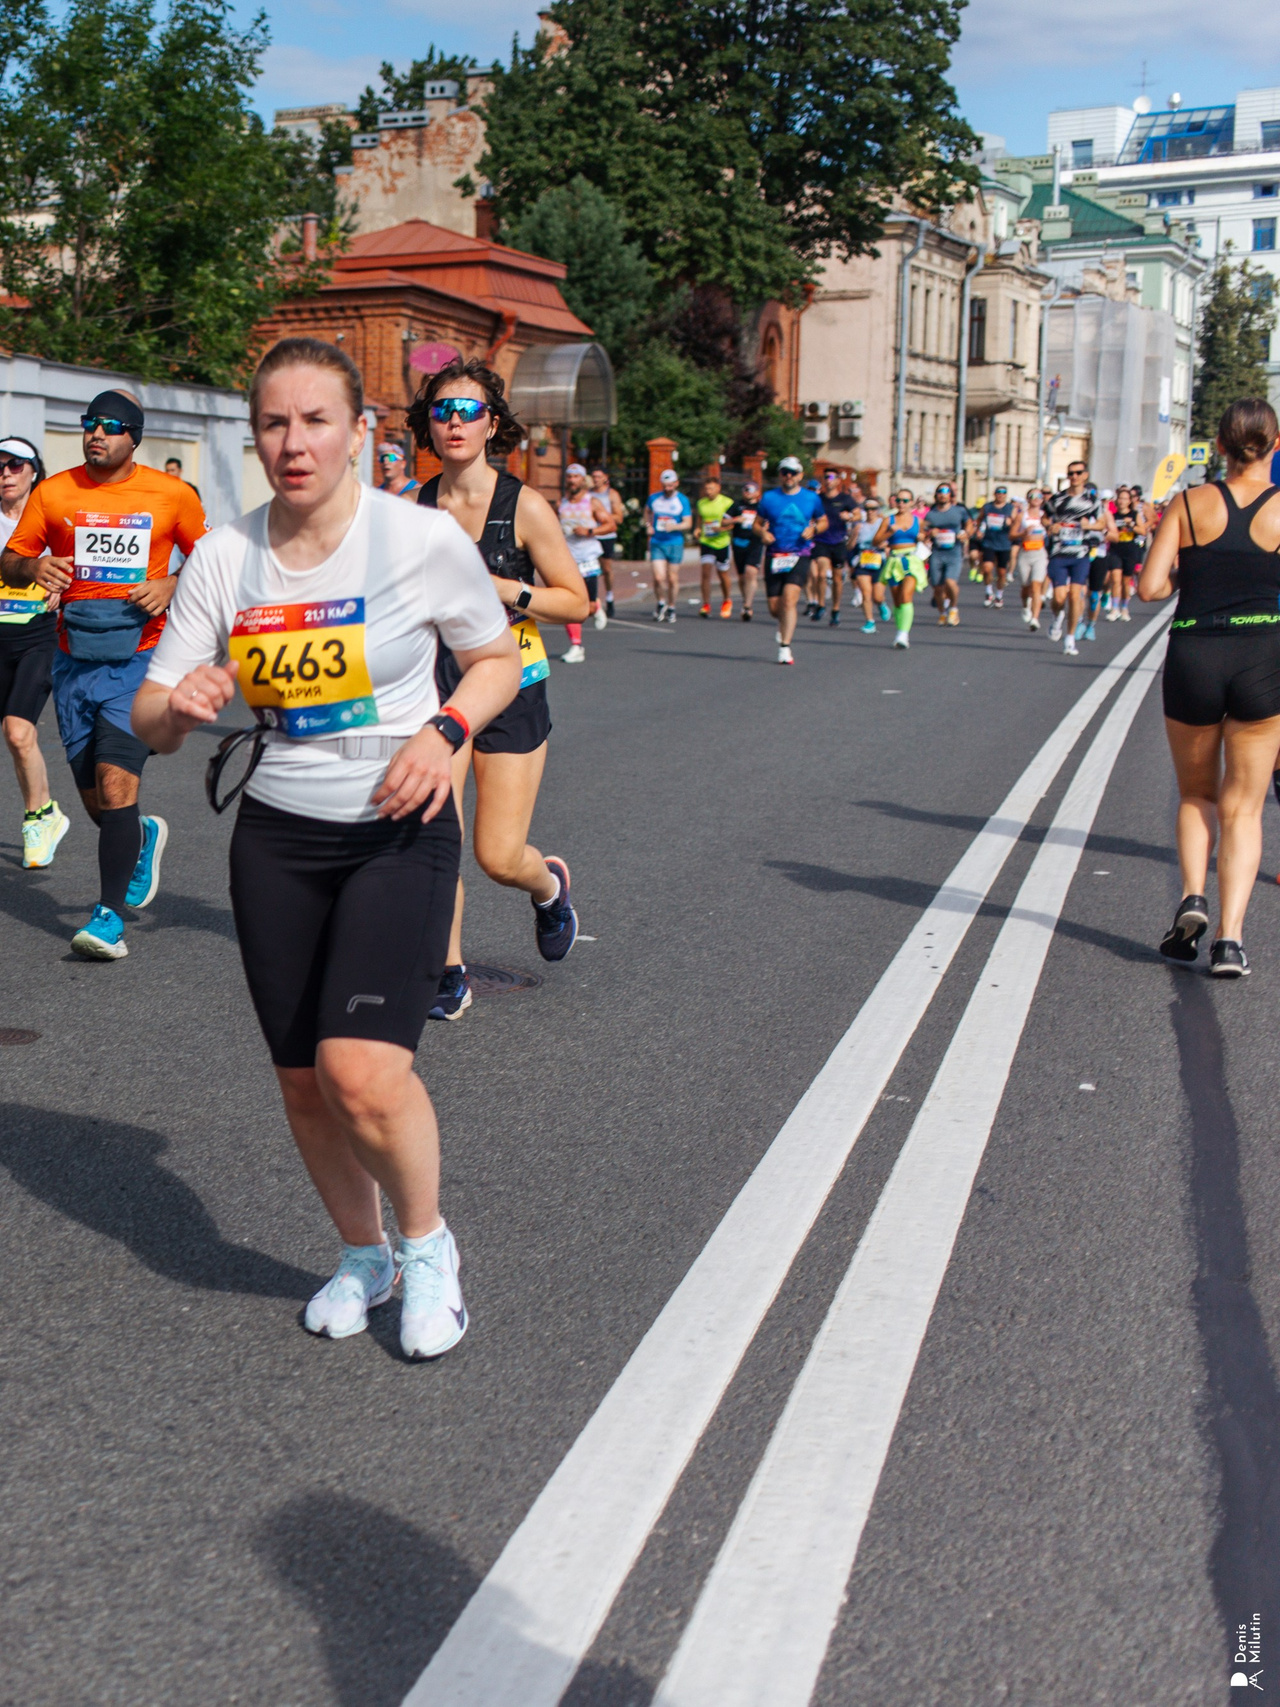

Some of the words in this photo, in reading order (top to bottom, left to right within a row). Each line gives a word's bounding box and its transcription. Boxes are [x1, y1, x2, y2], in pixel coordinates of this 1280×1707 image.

[1166, 460, 1174, 473] 6
[86, 533, 139, 555] 2566
[92, 555, 131, 563] ВЛАДИМИР
[81, 567, 90, 579] D
[303, 608, 325, 622] 21,1
[247, 639, 347, 686] 2463
